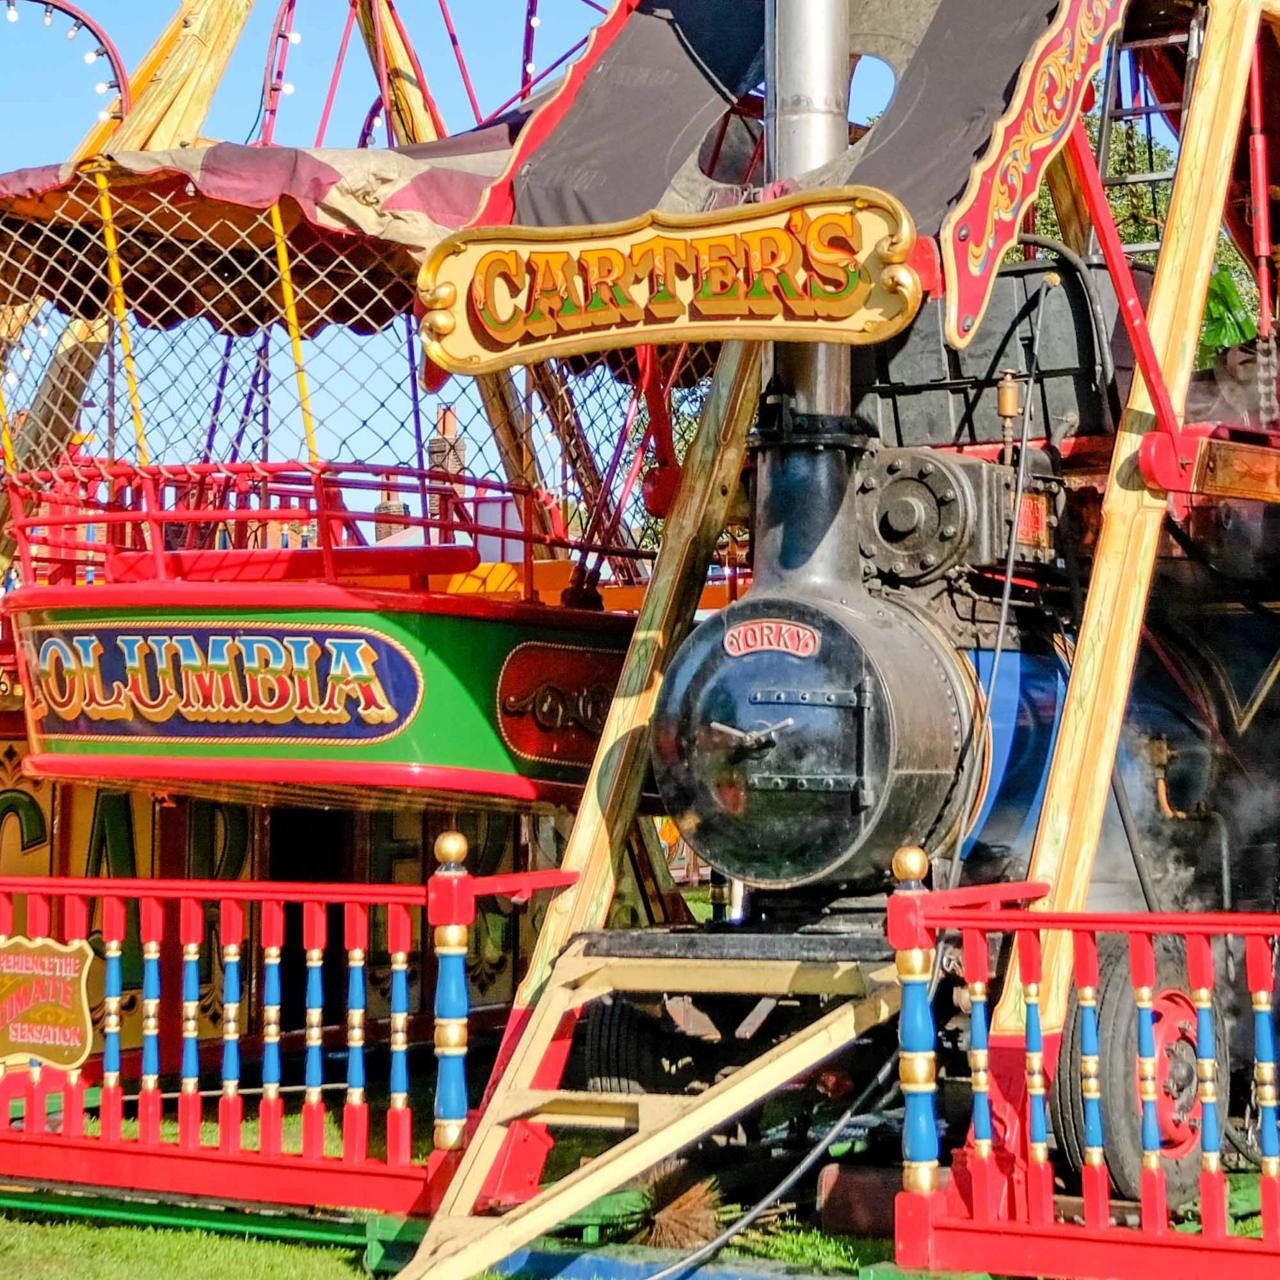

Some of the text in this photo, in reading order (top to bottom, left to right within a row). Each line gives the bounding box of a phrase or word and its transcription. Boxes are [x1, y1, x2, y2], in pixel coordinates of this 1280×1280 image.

[468, 209, 868, 346] CARTER'S
[730, 624, 808, 652] YORKY
[28, 634, 397, 722] OLUMBIA
[55, 956, 80, 978] THE
[8, 1023, 82, 1047] SENSATION
